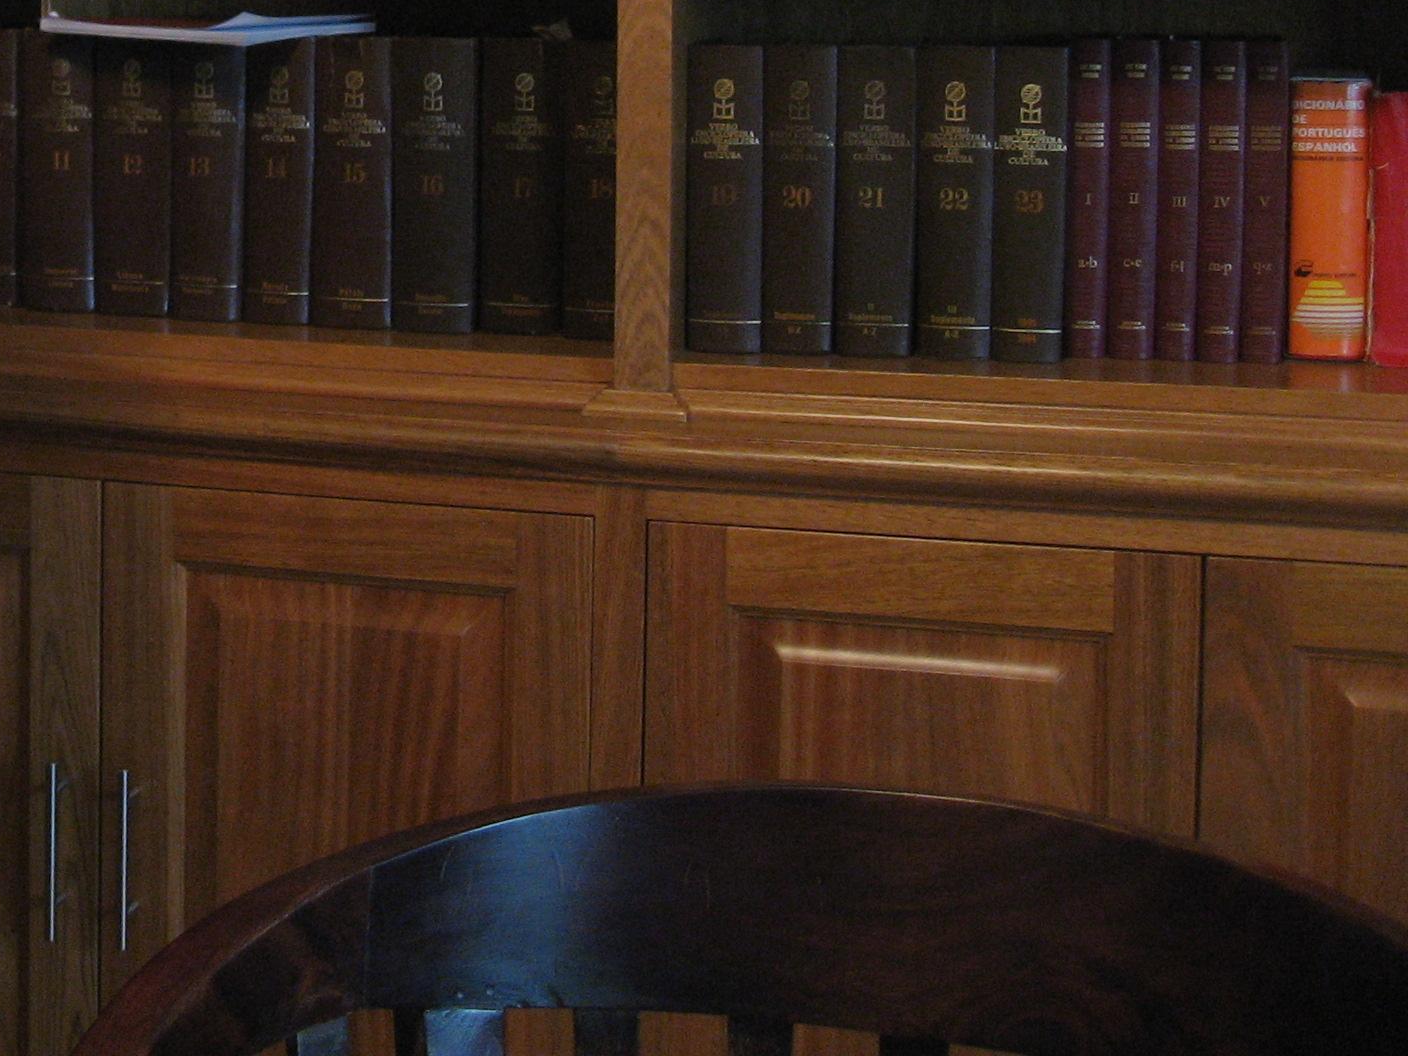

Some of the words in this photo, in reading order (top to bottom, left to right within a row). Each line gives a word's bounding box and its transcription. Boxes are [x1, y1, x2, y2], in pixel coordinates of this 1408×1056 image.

[1291, 142, 1358, 153] ESPANHOL
[783, 185, 812, 209] 20
[859, 186, 884, 209] 21
[940, 187, 969, 211] 22
[1085, 192, 1091, 206] I
[1128, 192, 1139, 205] II
[1172, 195, 1187, 208] III
[1214, 196, 1230, 208] IV
[1259, 196, 1271, 208] V
